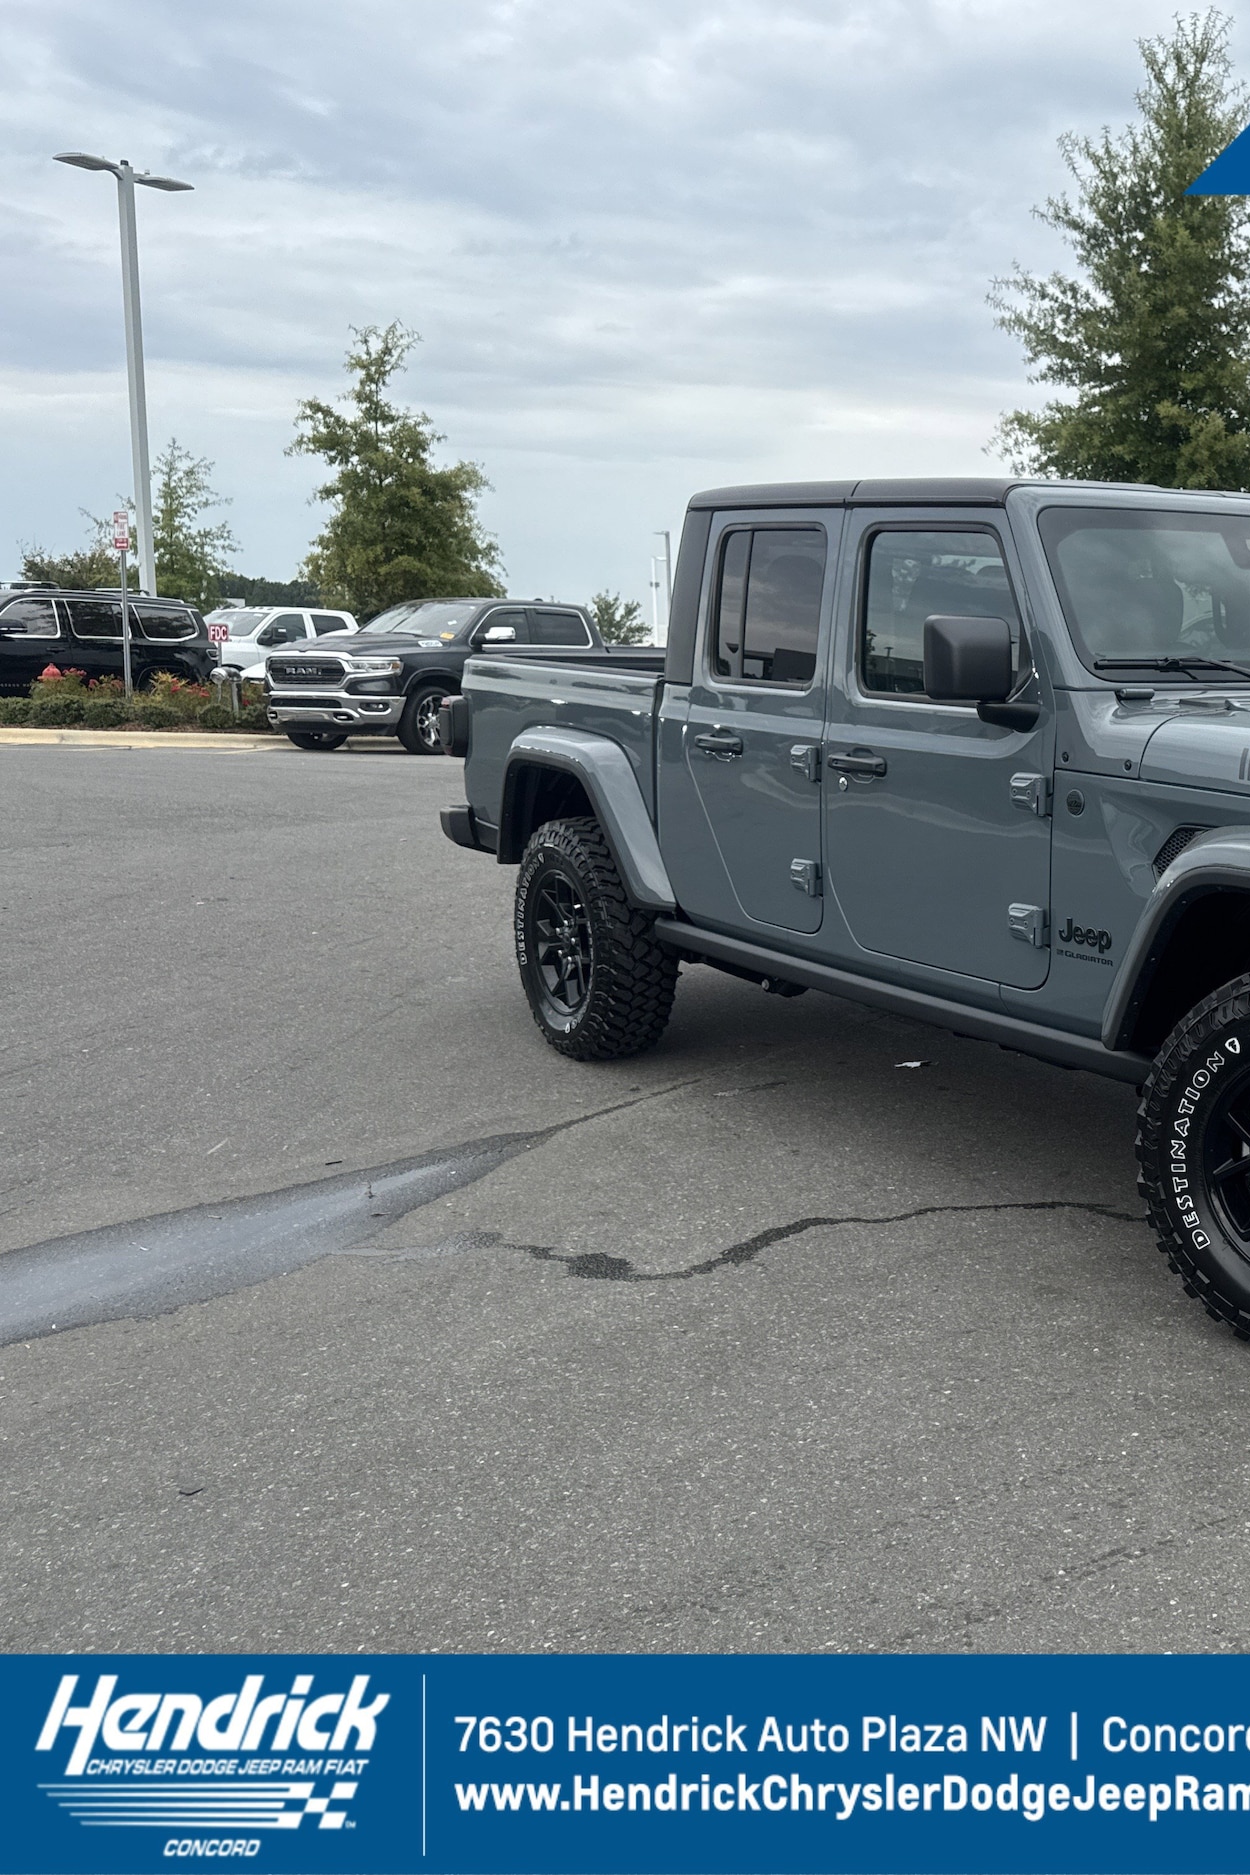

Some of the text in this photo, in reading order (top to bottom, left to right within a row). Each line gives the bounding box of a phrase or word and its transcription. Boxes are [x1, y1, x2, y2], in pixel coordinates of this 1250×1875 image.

[211, 626, 228, 640] FDC
[285, 666, 319, 676] RAM
[1059, 917, 1112, 954] Jeep
[1064, 949, 1114, 967] GLADIATOR
[1169, 1049, 1226, 1250] DESTINATION
